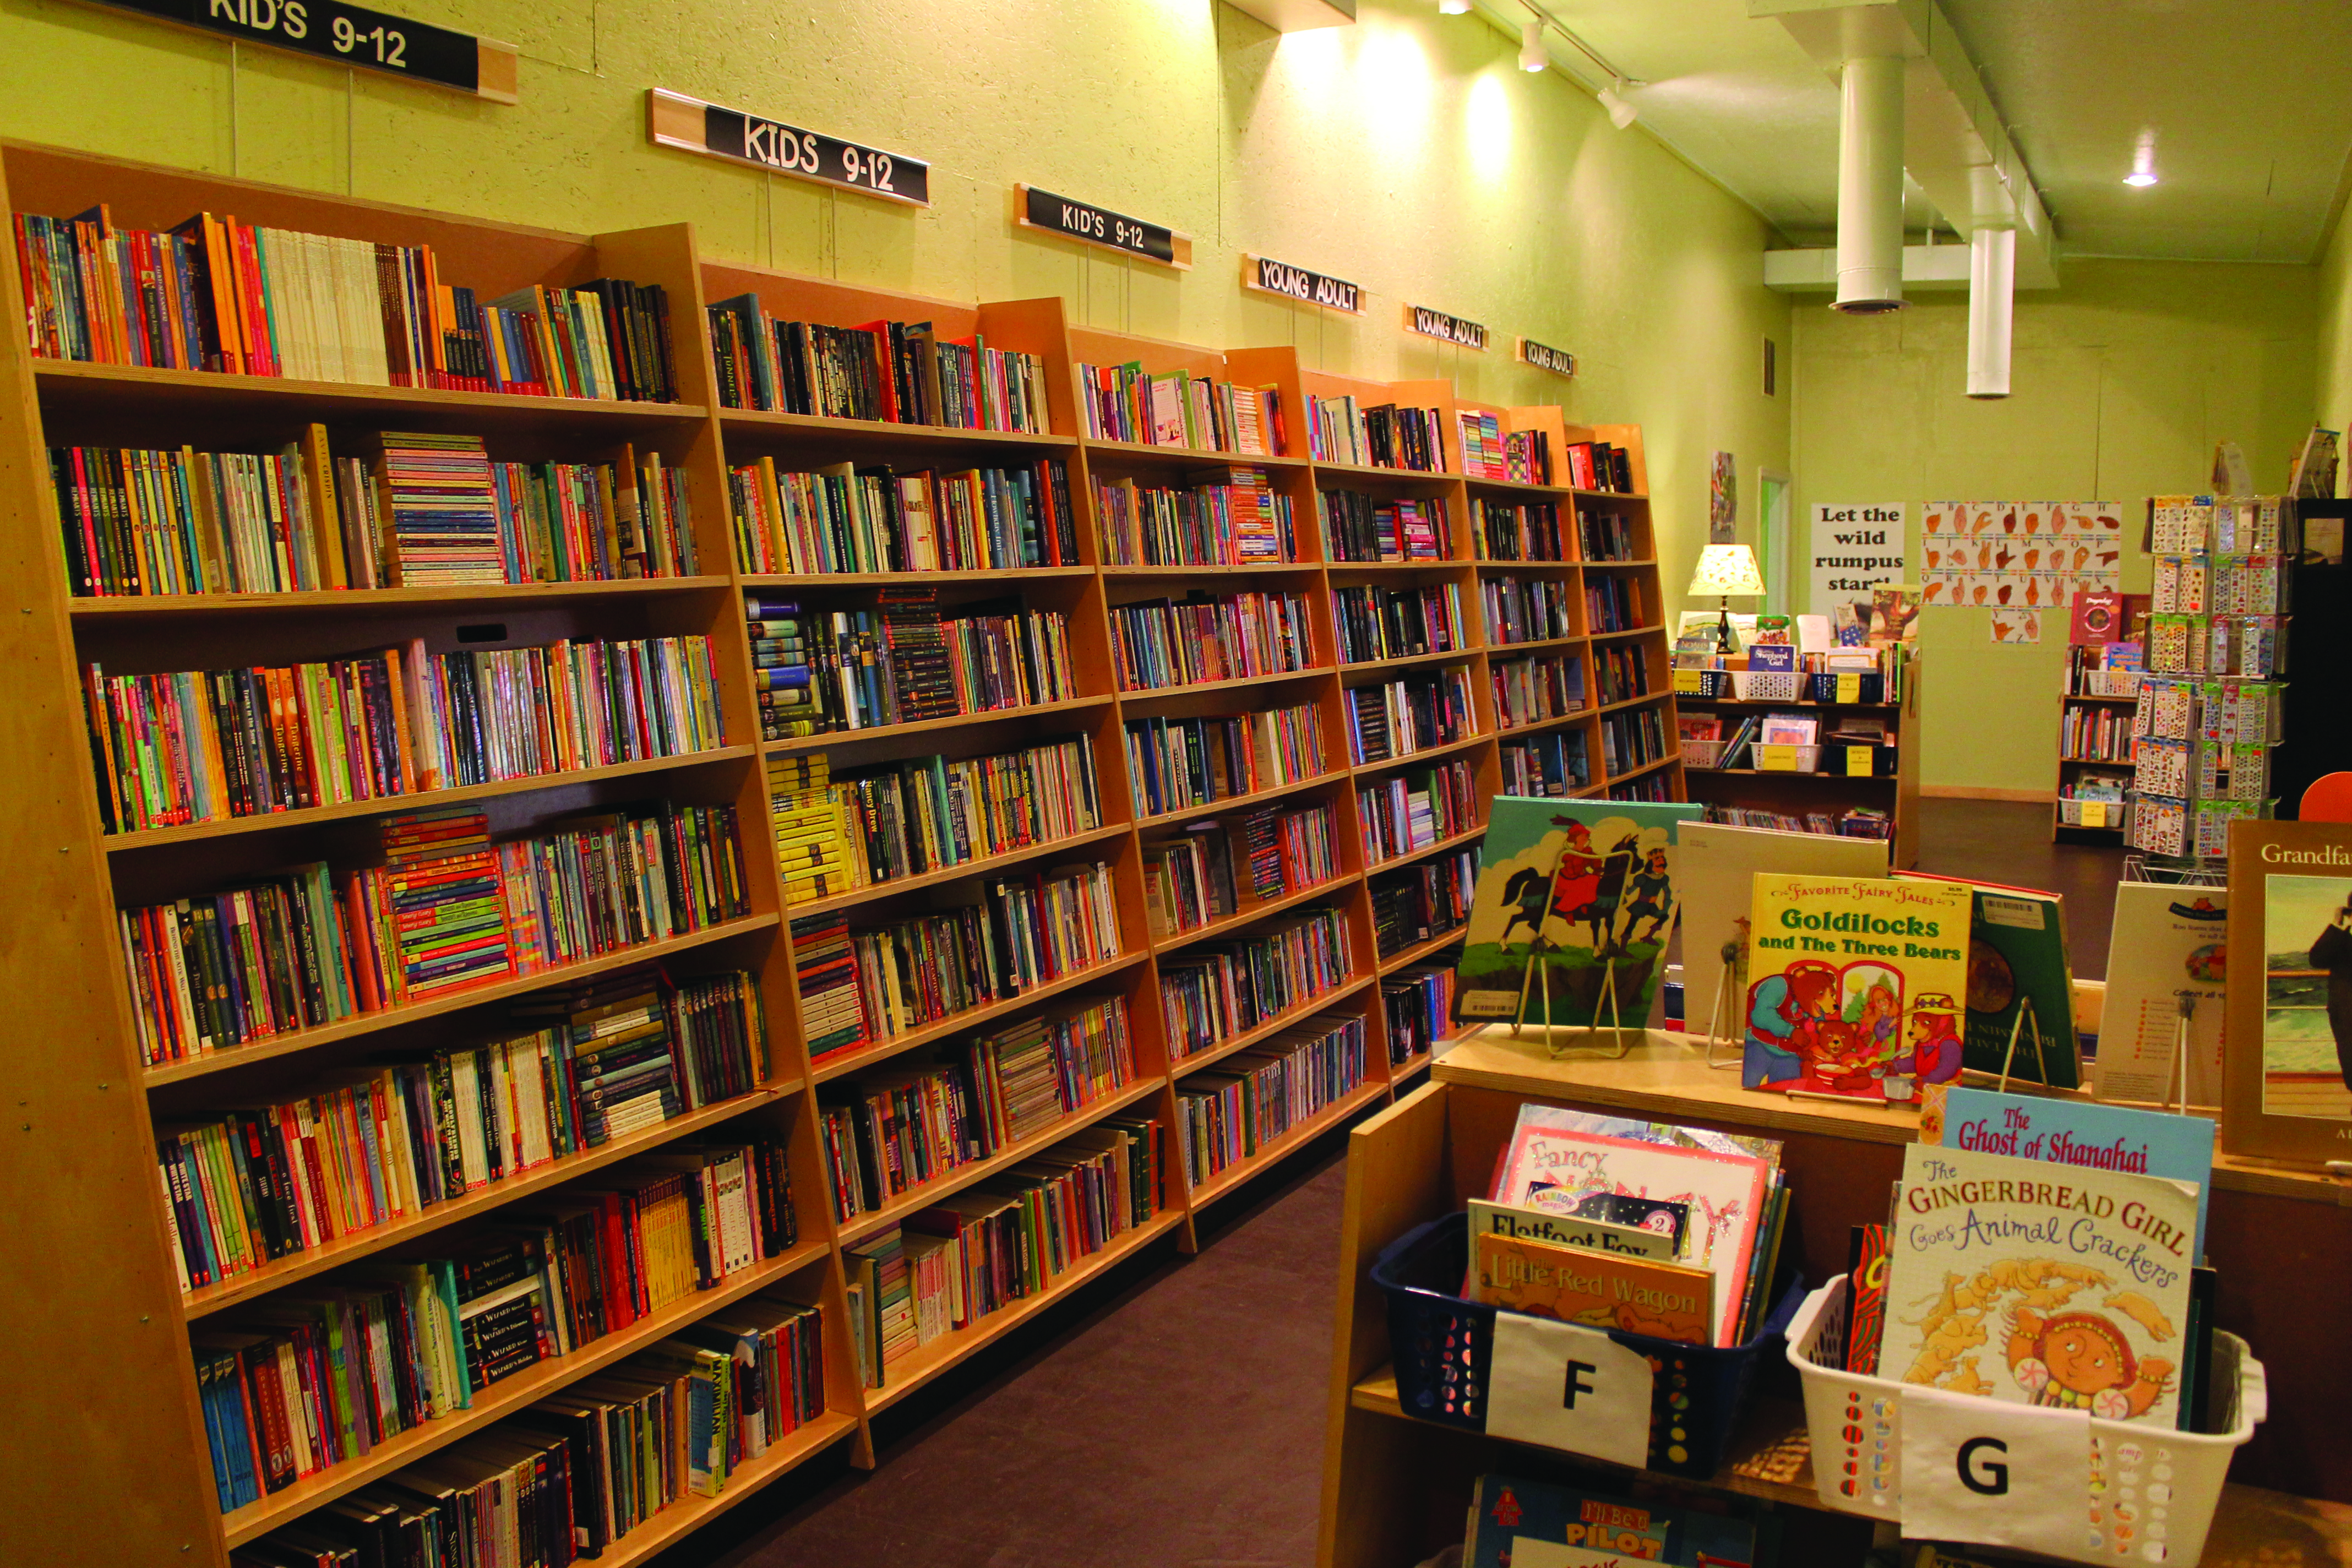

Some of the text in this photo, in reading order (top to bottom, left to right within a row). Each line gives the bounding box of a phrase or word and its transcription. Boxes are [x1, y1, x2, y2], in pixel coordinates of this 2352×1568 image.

[333, 18, 407, 68] 9-12
[744, 116, 894, 192] KIDS 9-12
[1062, 204, 1144, 248] KID'S 9-12
[1261, 260, 1357, 310] YOUNG ADULT
[1415, 307, 1483, 347] YOUNG ADULT
[1526, 343, 1573, 374] YOUNG ADULT
[723, 355, 738, 398] TUNNELS
[322, 465, 332, 499] CRISPIN
[70, 486, 81, 516] REMNANTS
[79, 486, 91, 516] REMNANTS
[90, 486, 100, 517] REMNANTS
[99, 486, 110, 517] REMNANTS
[107, 488, 118, 518] REMNANTS
[117, 487, 128, 517] REMNANTS
[1821, 508, 1900, 521] Let the
[587, 511, 599, 562] CHASING VERMEER
[988, 494, 1003, 551] Howliday Inn
[1833, 531, 1886, 545] wild
[1815, 556, 1904, 570] rumpus
[1755, 649, 1788, 661] Shepherd
[243, 688, 252, 709] Tracks
[275, 723, 289, 774] Tangerine
[290, 722, 303, 771] Tangerine
[863, 780, 879, 832] Nancy Drew
[1788, 883, 1934, 906] FAVORITE FAIRY TALES
[170, 926, 179, 950] BEHIND
[1781, 908, 1940, 938] Goldilocks
[374, 922, 383, 940] Henry
[380, 954, 389, 975] Beezus
[1758, 936, 1962, 960] and The Three Bears
[925, 940, 939, 998] INDIAN CAPTIVE
[547, 1101, 559, 1139] REVOLUTION
[2004, 1107, 2030, 1130] The
[1529, 1141, 1609, 1172] Fancy
[1959, 1119, 2148, 1174] Ghost of Shanghai
[168, 1163, 184, 1203] WHITE STAR
[177, 1161, 193, 1201] WHITE STAR
[1923, 1160, 1957, 1182] The
[1535, 1193, 1577, 1207] RAINBOW
[1542, 1201, 1565, 1210] magic
[1493, 1214, 1596, 1247] Flatfoot
[1655, 1218, 1665, 1232] 2
[1908, 1180, 2187, 1257] GINGERBREAD GIRL
[1910, 1208, 2179, 1288] Goes Animal Crackers
[1491, 1254, 1696, 1314] Little Red Wagon
[486, 1308, 510, 1321] WIZARD
[482, 1327, 510, 1341] WIZARD'S
[492, 1343, 516, 1357] WIZARD
[491, 1362, 518, 1376] WIZARD'S
[1562, 1359, 1597, 1410] F
[711, 1360, 722, 1435] MAXIMILIAN
[1957, 1436, 2010, 1496] G
[1586, 1502, 1647, 1529] I'll Be a
[1566, 1523, 1662, 1560] PILOT
